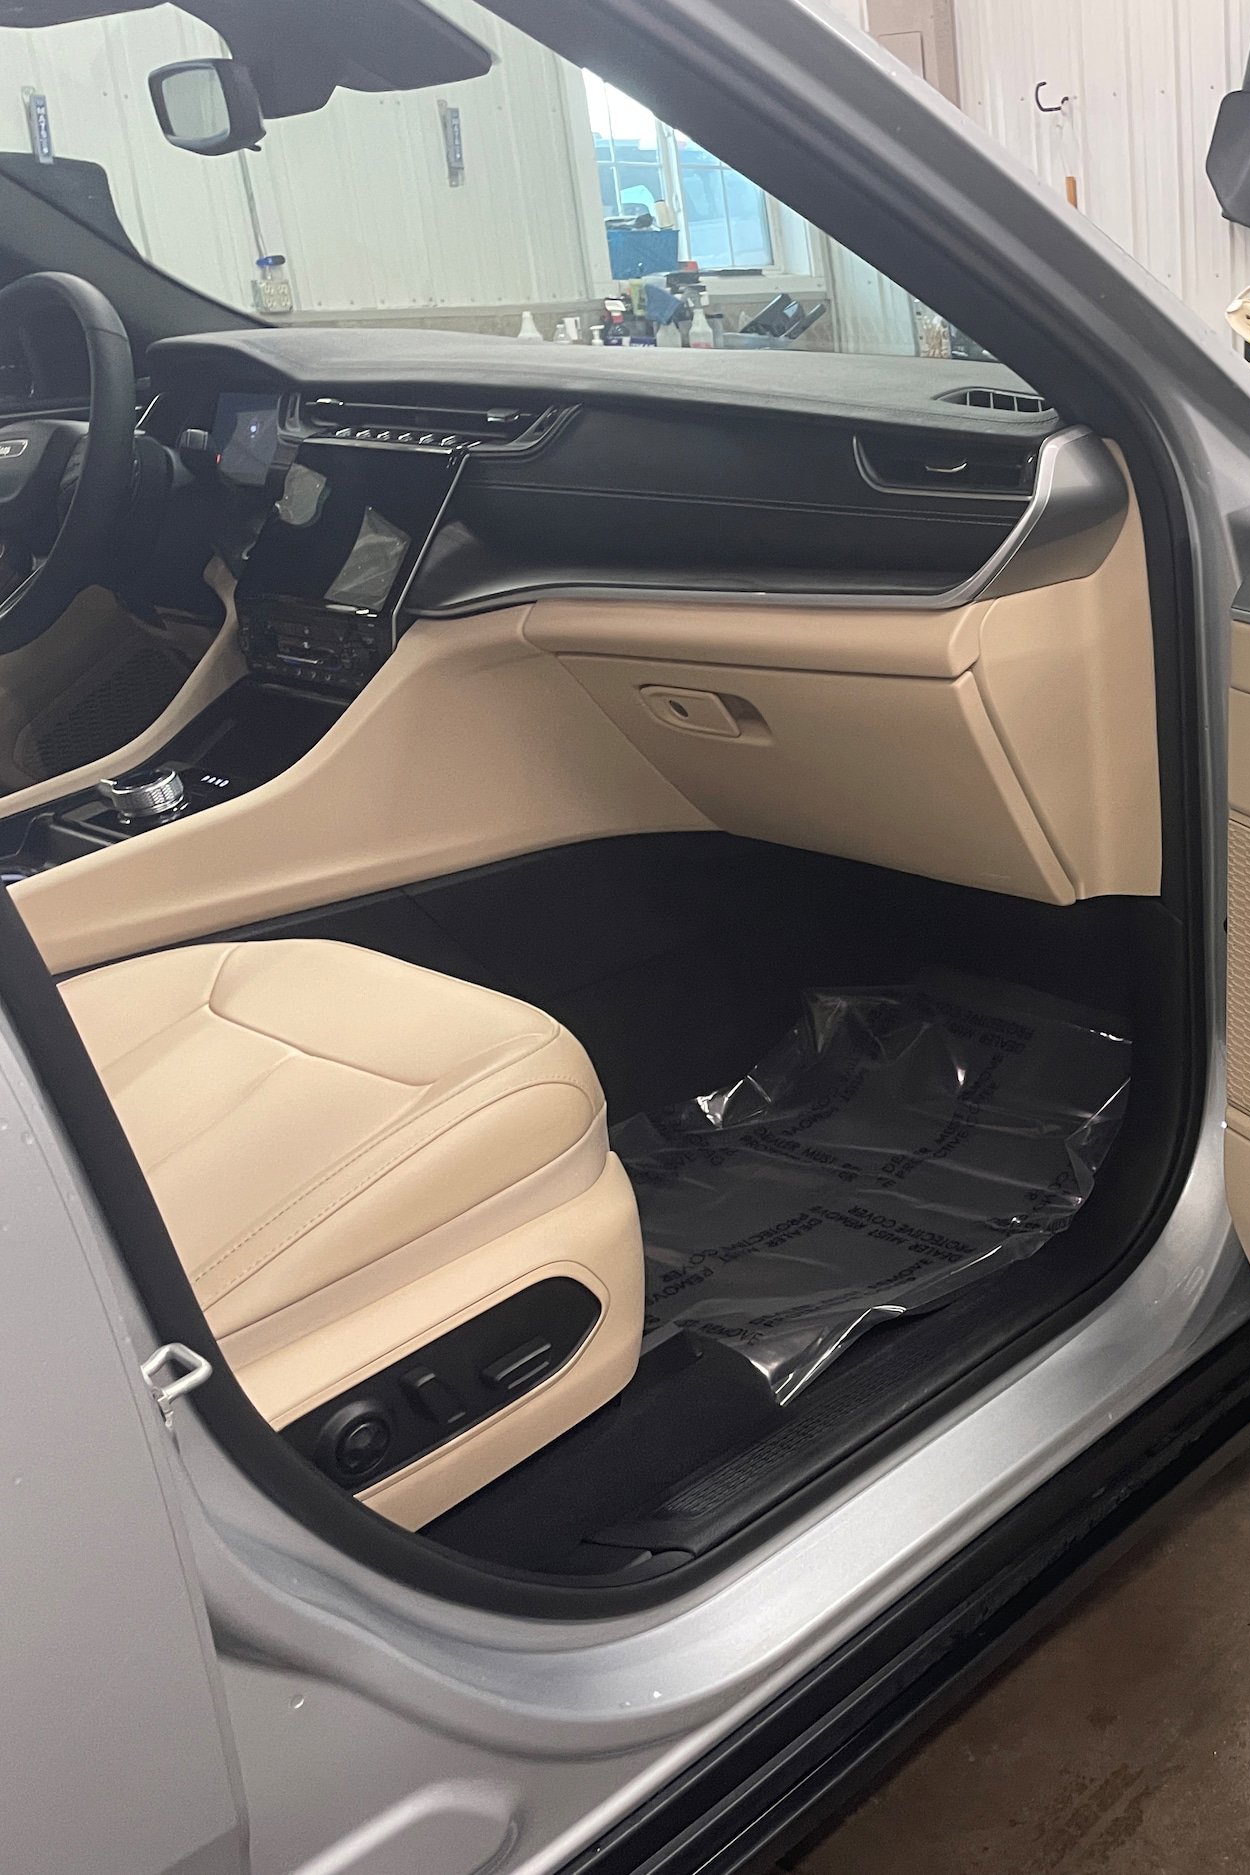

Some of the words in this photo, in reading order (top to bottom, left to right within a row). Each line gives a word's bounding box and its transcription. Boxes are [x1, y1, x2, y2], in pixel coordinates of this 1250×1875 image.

[809, 1204, 868, 1230] REMOVE
[847, 1204, 897, 1229] COVER
[764, 1217, 822, 1248] DEALER
[867, 1227, 910, 1245] MUST
[894, 1223, 978, 1254] PROTECTIVE
[907, 1243, 964, 1263] DEALER
